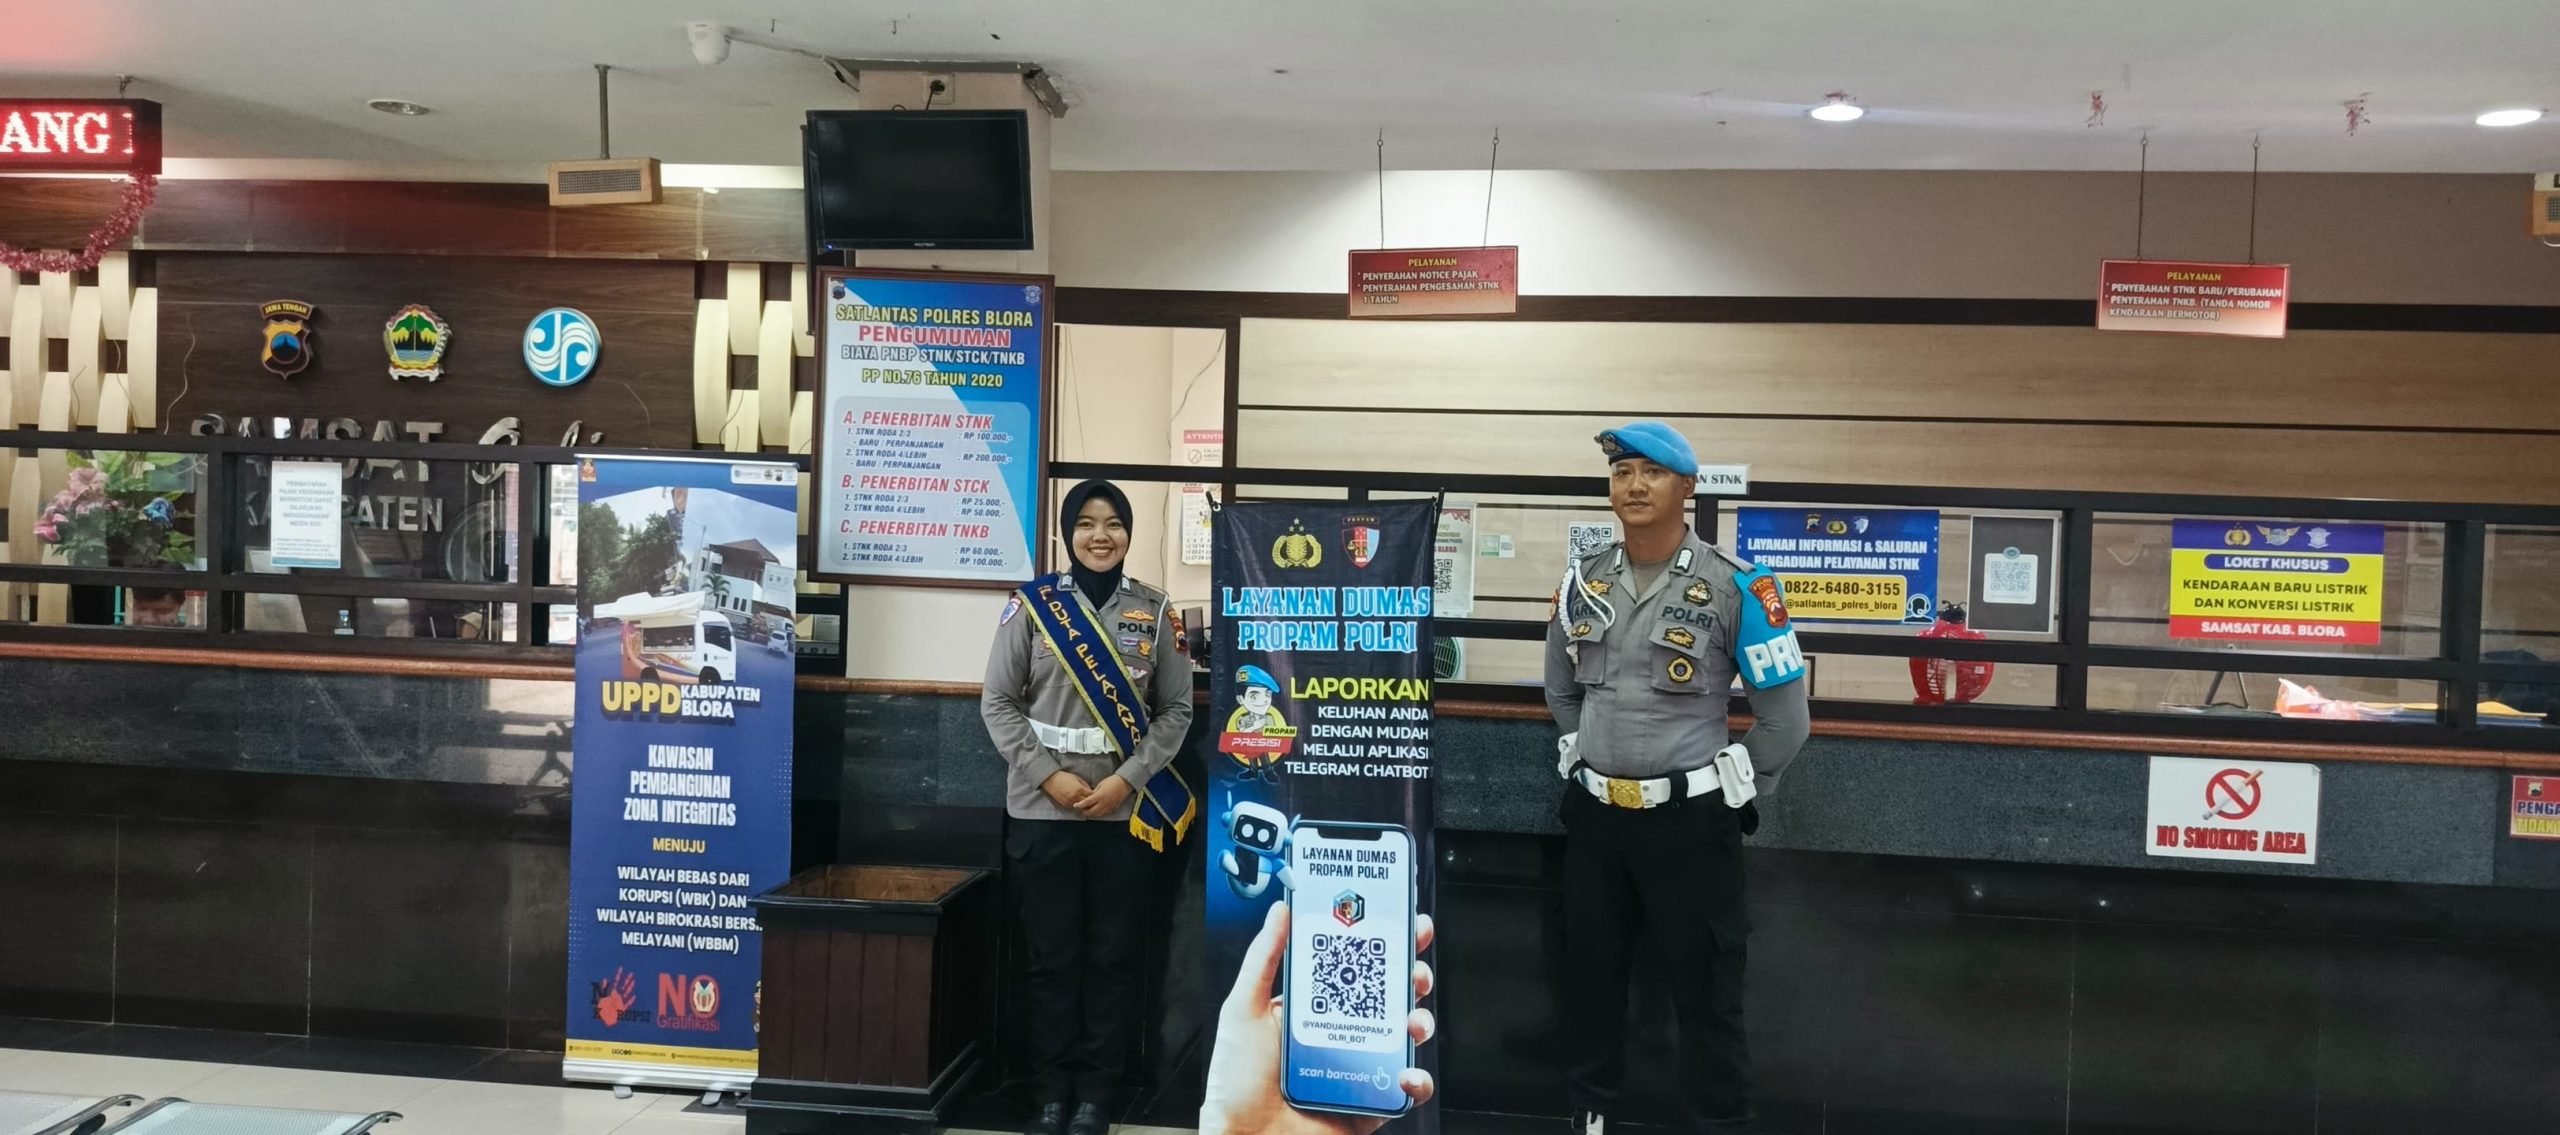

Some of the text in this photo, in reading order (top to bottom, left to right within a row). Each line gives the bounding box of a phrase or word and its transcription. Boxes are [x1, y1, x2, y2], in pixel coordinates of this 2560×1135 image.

[1408, 258, 1457, 267] PELAYANAN
[1363, 271, 1478, 281] PENYERAHAN NOTICE PAJAK
[2167, 272, 2221, 281] PELAYANAN
[1363, 281, 1499, 292] PENYERAHAN PENGESAHAN STNK
[2111, 283, 2281, 297] PENYERAHAN STNK BARU/PERUBAHAN
[1370, 296, 1398, 304] TAHUN
[2110, 295, 2169, 306] PENYERAHAN
[2200, 299, 2234, 308] (TANDA
[2237, 300, 2270, 309] NOMOR
[836, 304, 1033, 327] SATLANTAS POLRES BLORA
[2110, 309, 2220, 321] KENDARAAN BERMOTOR)
[858, 324, 1012, 348] PENGUMUMAN
[841, 345, 1026, 366] BIAYA PNBP STNK/STCK/TNKB
[862, 368, 1003, 388] PP NO.76 TAHUN 2020
[843, 410, 993, 430] A. PENERBITAN STNK
[855, 428, 875, 436] STNK
[876, 429, 897, 437] RODA
[964, 432, 974, 440] RP
[858, 439, 944, 449] BARU PERPANJANGAN
[855, 449, 874, 457] STNK
[876, 450, 896, 458] RODA
[856, 460, 941, 470] BARU PERPANJANGAN
[842, 474, 991, 494] B. PENERBITAN STCK
[1711, 474, 1742, 485] STNK
[853, 493, 873, 502] STNK
[875, 494, 895, 503] RODA
[962, 497, 973, 506] RP
[853, 504, 872, 512] STNK
[874, 505, 894, 513] RODA
[961, 508, 972, 516] RP
[840, 519, 989, 539] C. PENERBITAN TNKB
[852, 542, 872, 551] STNK
[873, 543, 893, 552] RODA
[960, 546, 970, 554] RP
[1748, 538, 1927, 554] LAYANAN INFORMASI & SALURAN
[851, 553, 871, 561] STNK
[872, 554, 893, 562] RODA
[959, 557, 970, 565] RP
[1754, 554, 1920, 571] PENGADUAN PELAYANAN STNK
[2224, 556, 2329, 571] LOKET KHUSUS
[1784, 579, 1900, 597] 0822-6480-3155
[2183, 579, 2368, 595] KENDARAAN BARU LISTRIK
[1222, 586, 1431, 617] LAYANAN DUMAS
[1784, 599, 1898, 611] @satlantas_polres_blora
[2194, 597, 2354, 613] DAN KONVERSI LISTRIK
[1048, 601, 1082, 641] DUTA
[1661, 605, 1713, 628] POLRI
[1238, 621, 1418, 653] PROPAM POLRI
[2201, 621, 2345, 638] SAMSAT KAB. BLORA
[602, 680, 760, 714] UPPD KABUPATEN
[1290, 677, 1429, 701] LAPORKAN
[681, 699, 735, 718] BLORA
[1318, 706, 1429, 721] KELUHAN ANDA
[1264, 726, 1296, 735] PROPAM
[1311, 724, 1429, 740] DENGAN MUDAH
[1231, 737, 1282, 748] PRESISI
[648, 744, 714, 771] KAWASAN
[1303, 744, 1429, 760] MELALUI APLIKASI
[1285, 761, 1429, 779] TELEGRAM CHATBOT
[630, 770, 731, 799] PEMBANGUNAN
[623, 798, 736, 826] ZONA INTEGRITAS
[653, 837, 706, 853] MENUJU
[2157, 825, 2307, 854] NO SMOKING AREA
[1302, 846, 1397, 864] LAYANAN DUMAS
[617, 866, 750, 887] WILAYAH BEBAS DARI
[1309, 862, 1390, 880] PROPAM POLRI
[619, 887, 747, 910] KORUPSI (WBK) DAN
[596, 908, 763, 931] WILAYAH BIROKRASI BERS
[622, 931, 739, 954] MELAYANI (WBBM)
[658, 972, 720, 1018] NO
[656, 1014, 720, 1032] Gratifikasi
[1302, 1020, 1393, 1035] @YANDUANPROPAM_P
[1328, 1033, 1367, 1044] OLRI_BOT
[1299, 1066, 1370, 1083] scan barcode
